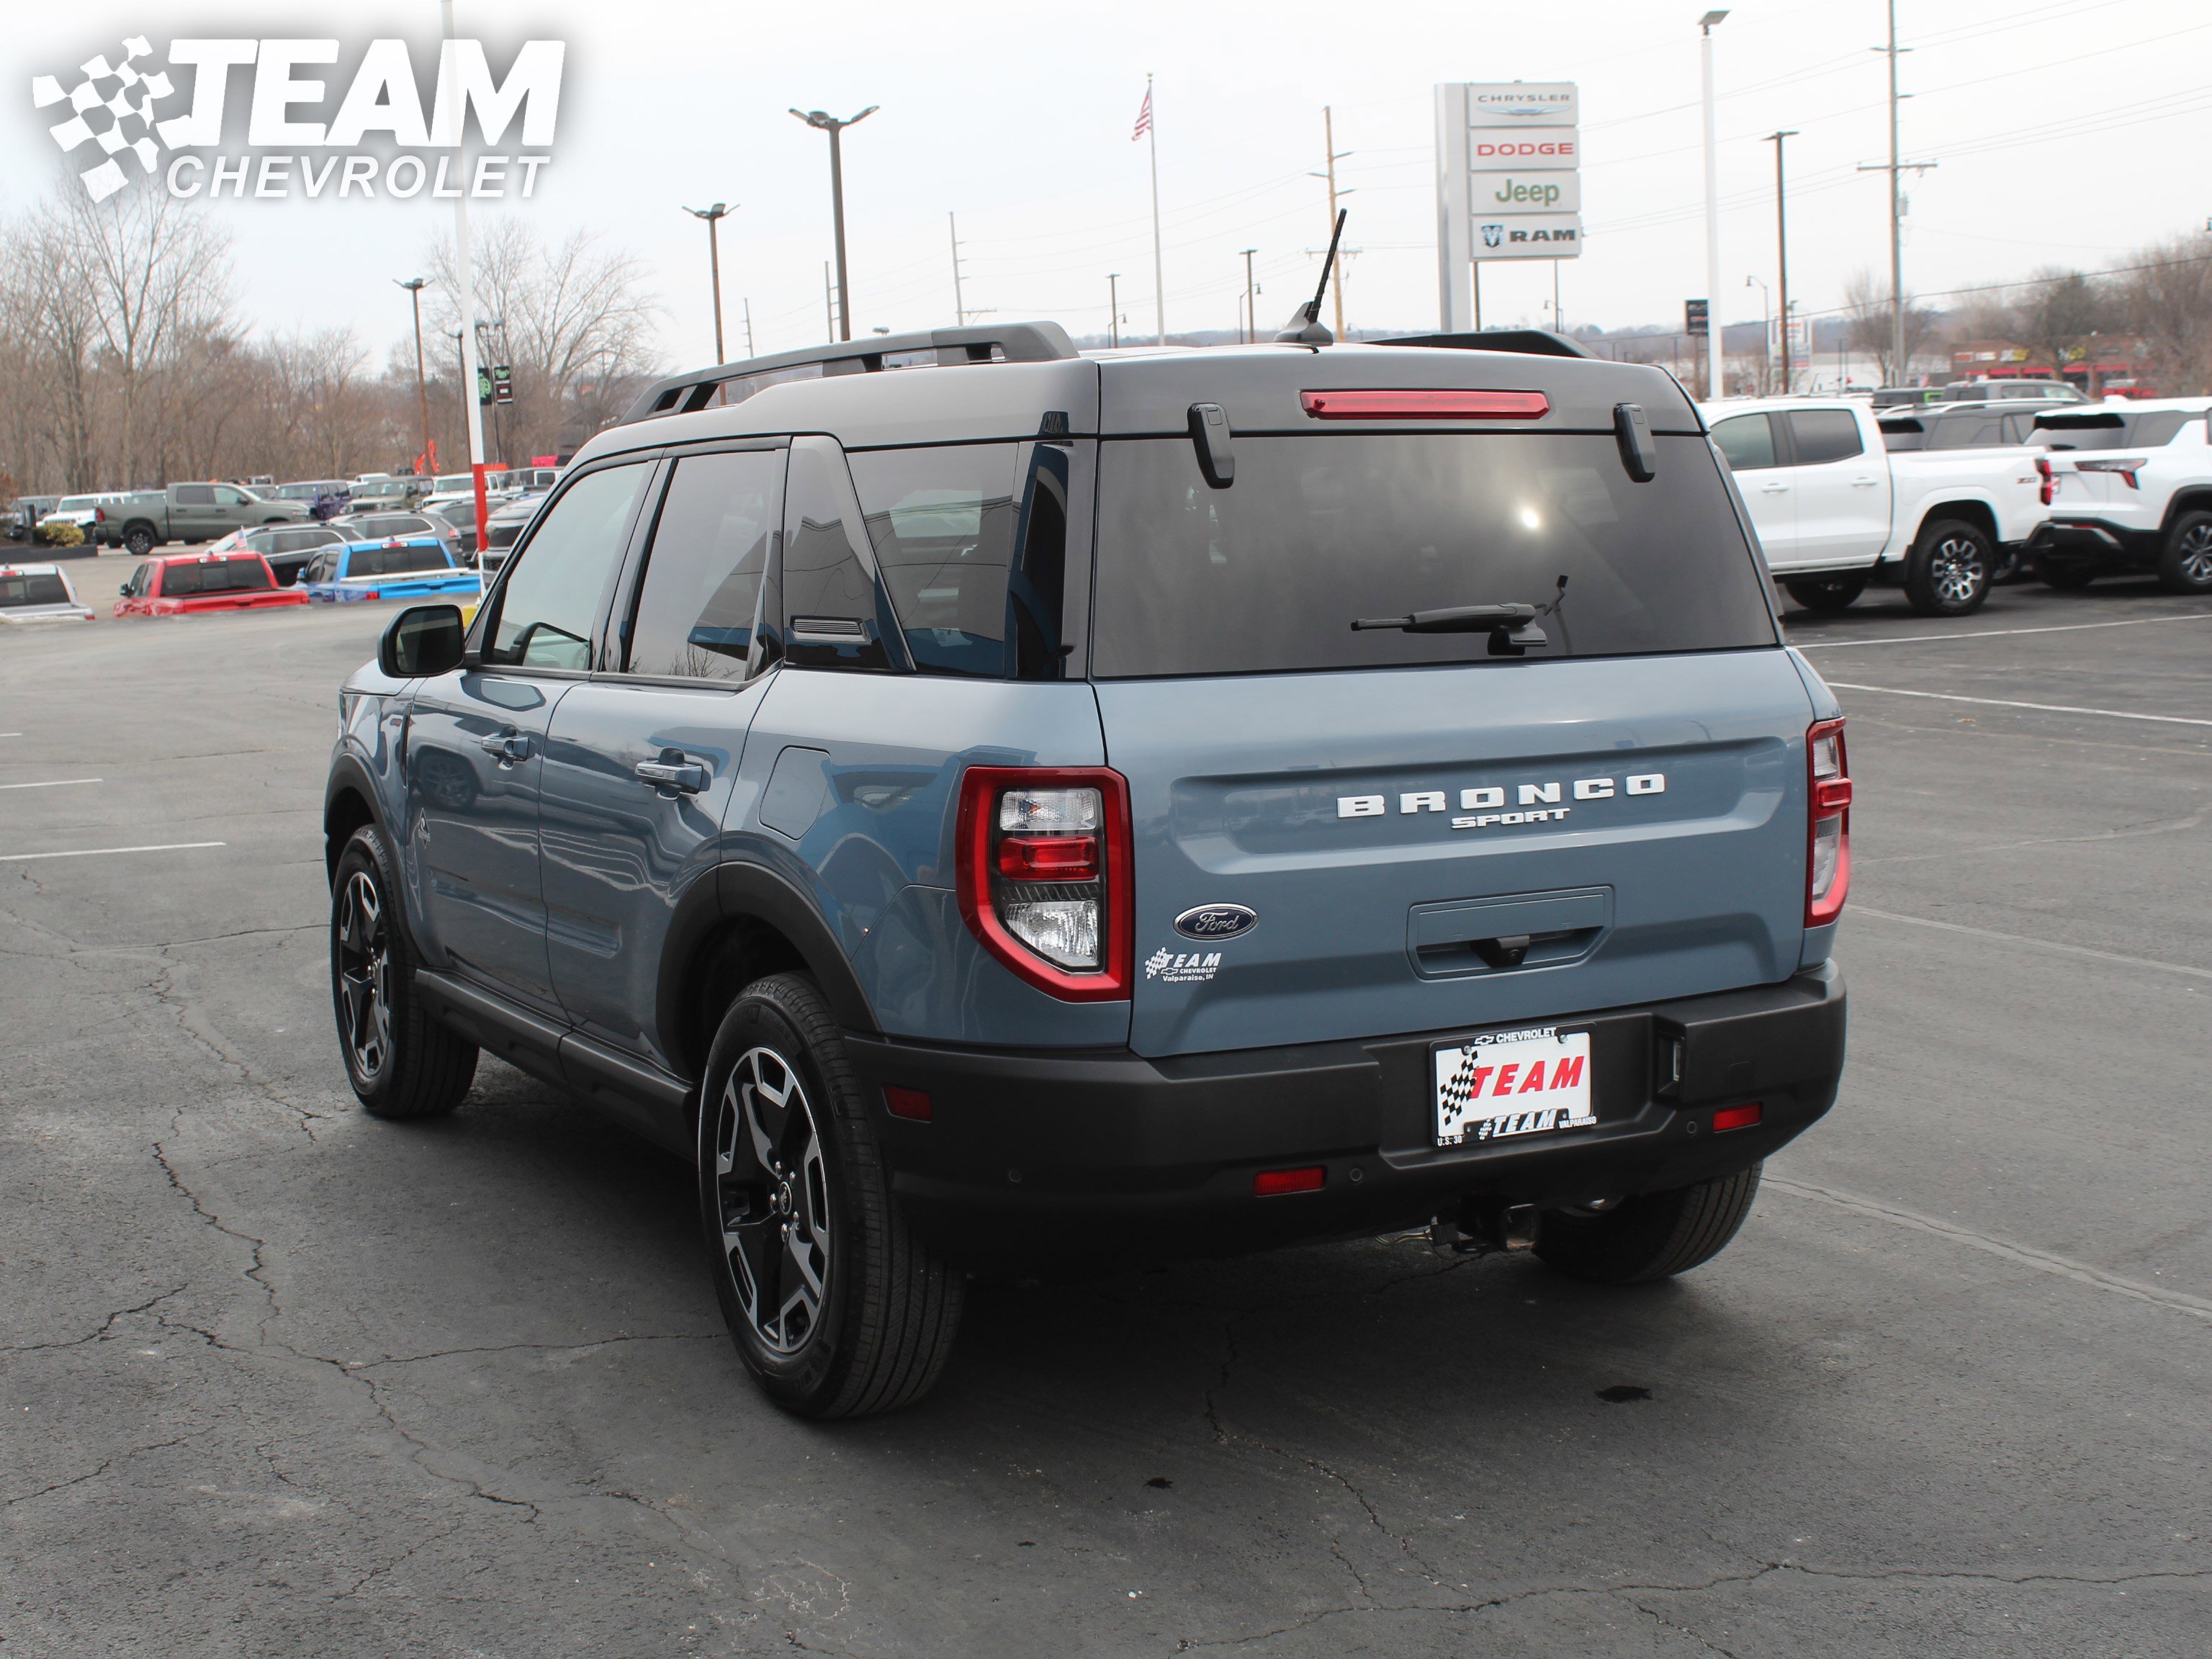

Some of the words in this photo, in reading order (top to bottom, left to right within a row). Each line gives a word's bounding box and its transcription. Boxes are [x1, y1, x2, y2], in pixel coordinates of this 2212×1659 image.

[1478, 94, 1570, 102] CHRYSLER
[1477, 143, 1574, 156] DODGE
[1495, 179, 1560, 206] Jeep
[1509, 229, 1575, 242] RAM
[1337, 773, 1665, 818] BRONCO
[1451, 808, 1570, 829] SPORT
[1195, 912, 1240, 932] Ford
[1162, 953, 1221, 968] TEAM
[1496, 1028, 1557, 1043] CHEVROLET
[1469, 1056, 1585, 1100] TEAM
[1493, 1109, 1557, 1135] TEAM
[1559, 1115, 1597, 1129] VALPARAISO
[1437, 1137, 1453, 1146] U.S.
[1453, 1136, 1462, 1144] 30
